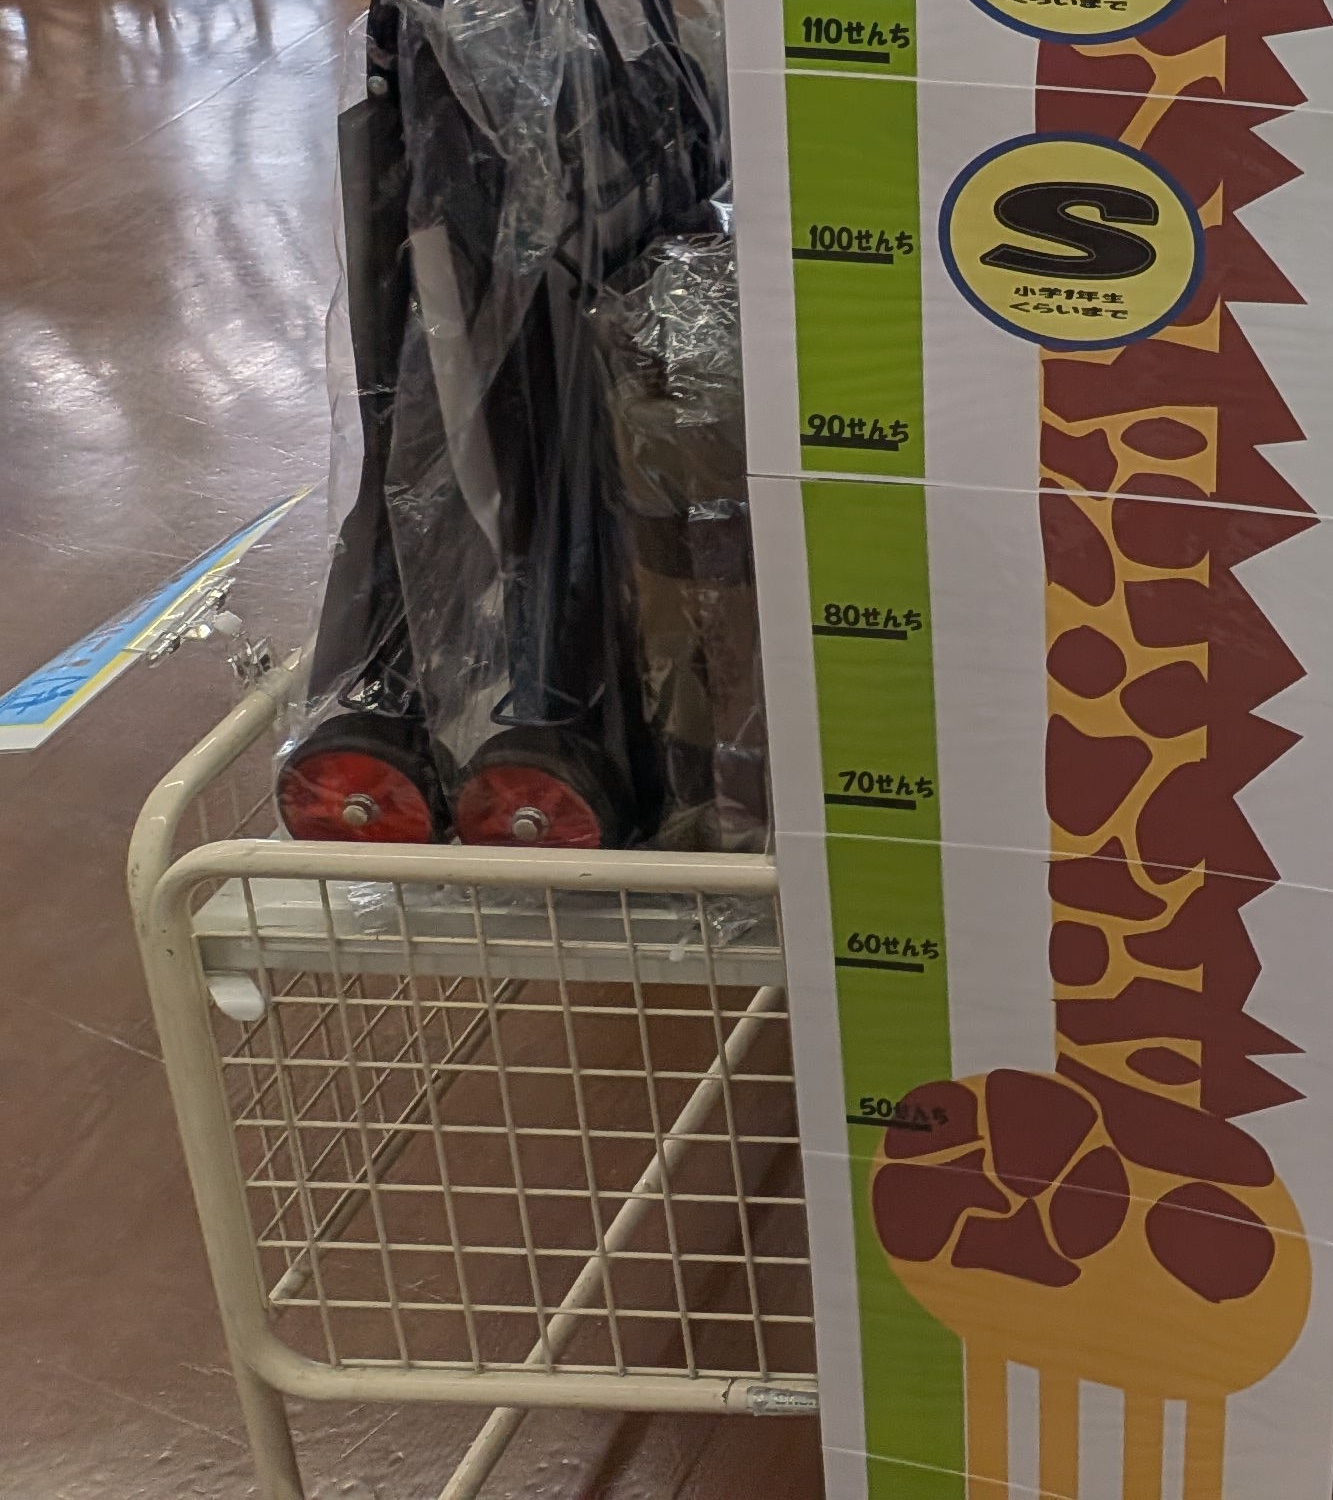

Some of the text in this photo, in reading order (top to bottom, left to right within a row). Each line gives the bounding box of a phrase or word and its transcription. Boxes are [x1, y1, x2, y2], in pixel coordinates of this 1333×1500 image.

[802, 18, 911, 48] 110せんち
[809, 225, 914, 256] 100せんち
[979, 181, 1160, 281] S
[1013, 285, 1125, 305] 小学1年生
[1009, 301, 1128, 320] くらいまで
[806, 413, 910, 443] 90せんち
[823, 603, 923, 631] 80せんち
[838, 770, 935, 800] 70せんち
[846, 931, 940, 961] 60せんち
[858, 1097, 949, 1126] 50せんち
